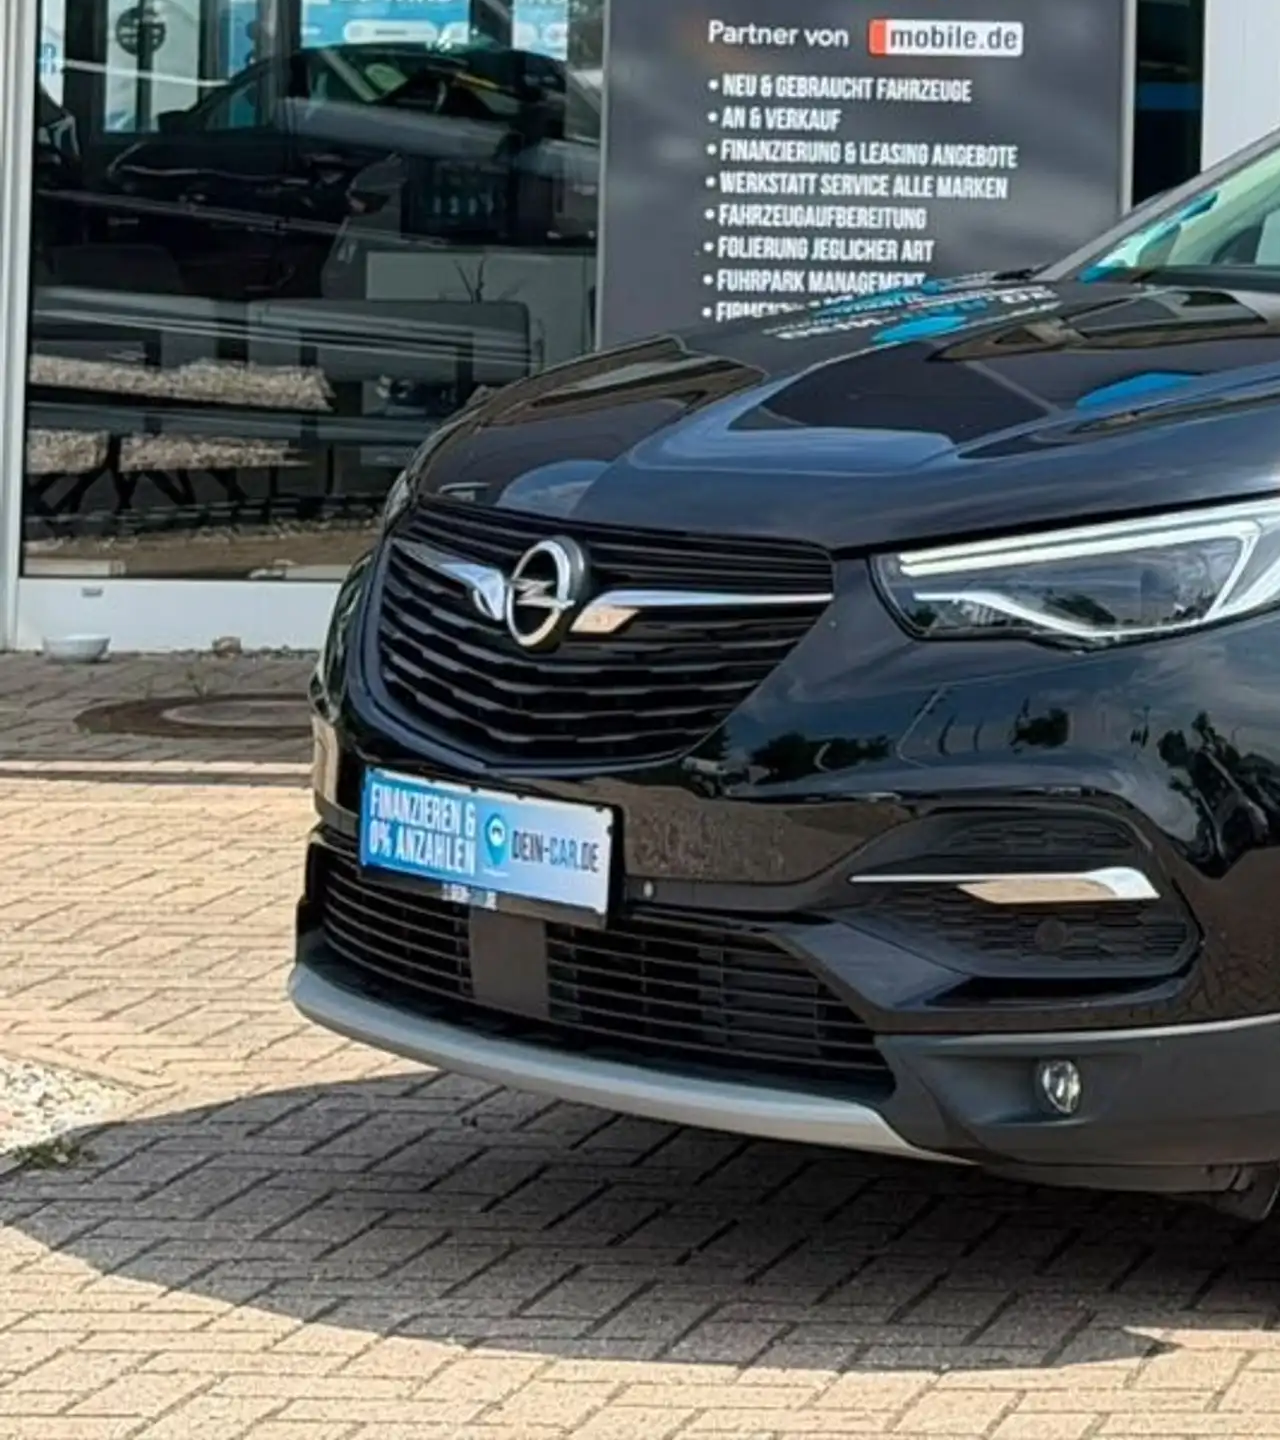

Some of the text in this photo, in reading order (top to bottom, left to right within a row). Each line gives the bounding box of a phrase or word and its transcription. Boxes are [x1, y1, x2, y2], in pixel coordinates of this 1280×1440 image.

[707, 19, 1019, 51] Partner von mobile.de
[722, 73, 973, 102] NEU & GEBRAUCHT FAHRZEUGE
[720, 106, 842, 131] AN & VERKAUF
[720, 138, 1018, 168] FINANZIERUNG & LEASING ANGEBOTE
[719, 171, 1008, 199] WERKSTATT SERVICE ALLE MARKEN
[718, 204, 927, 230] FAHRZEUGAUFBEREITUNG
[717, 236, 934, 263] FOLIERUNG JEGLICHER ART
[716, 268, 805, 293] FUHRPARK
[394, 824, 476, 877] ANZAHLEN
[511, 829, 600, 873] DEIN-CAR.DE
